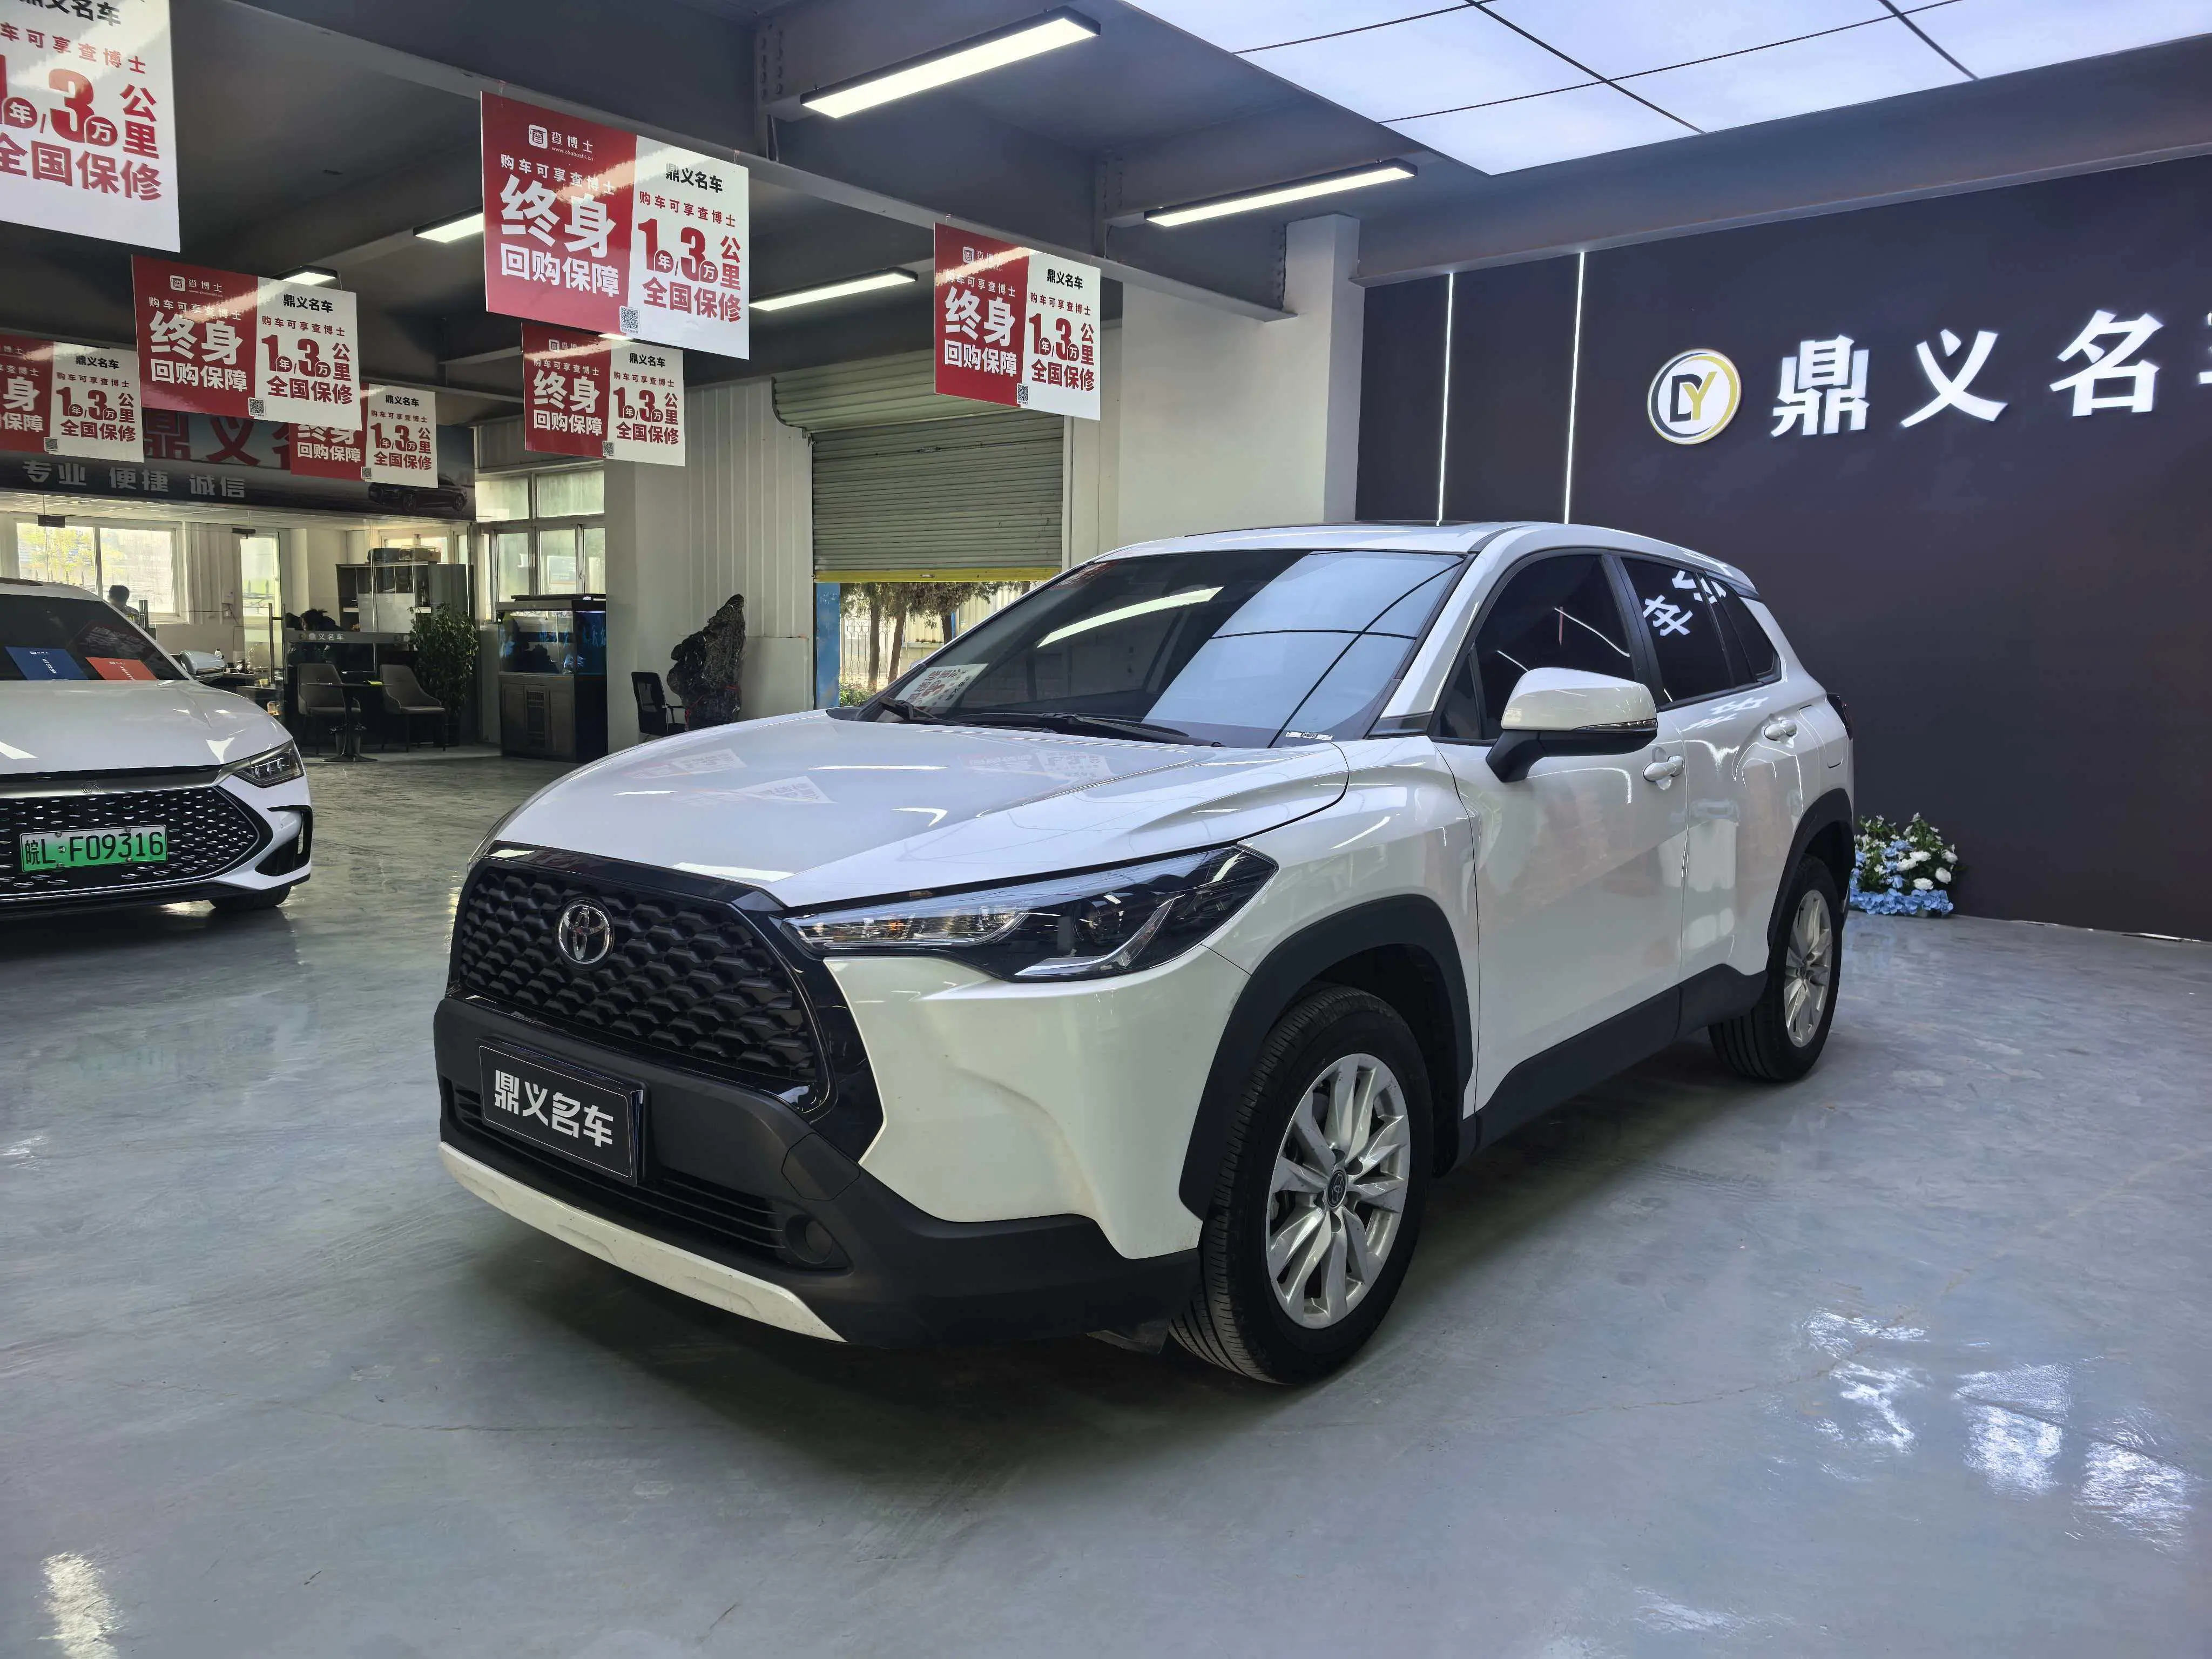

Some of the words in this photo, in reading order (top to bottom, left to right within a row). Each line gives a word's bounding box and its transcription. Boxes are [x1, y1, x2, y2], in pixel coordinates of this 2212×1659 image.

[0, 22, 146, 74] 车可享查博士
[551, 131, 593, 153] 查博士
[0, 132, 161, 201] 全国保修
[501, 153, 615, 195] 购车可享查博士
[666, 163, 723, 193] 鼎义名车
[500, 175, 616, 258] 终身
[639, 191, 736, 228] 购车可享查博士
[501, 243, 619, 298] 回购保障
[1047, 268, 1083, 290] 鼎义名车
[188, 279, 222, 292] 查博士
[642, 276, 741, 322] 全国保修
[149, 297, 241, 320] 购车可享查博士
[283, 294, 333, 313] 鼎义名车
[945, 286, 1016, 347] 终身
[1030, 292, 1091, 316] 购车可享查博士
[149, 311, 243, 366] 终身
[261, 315, 346, 337] 购车可享查博士
[75, 355, 119, 369] 鼎义名车
[629, 353, 666, 368] 鼎义名车
[945, 340, 1017, 377] 回购保障
[151, 359, 248, 392] 回购保障
[613, 371, 675, 387] 购车可享查博士
[1031, 359, 1095, 393] 全国保修
[1770, 309, 2212, 438] 鼎义名
[3, 376, 41, 412] 身
[266, 376, 353, 404] 全国保修
[386, 394, 420, 407] 鼎义名车
[533, 369, 601, 414] 终身
[0, 412, 44, 433] 保障
[60, 419, 136, 442] 全国保修
[533, 409, 603, 436] 回购保障
[616, 421, 679, 445] 全国保修
[298, 442, 361, 463] 回购保障
[374, 451, 432, 470] 全国保修
[22, 460, 87, 486] 专业
[109, 466, 169, 493] 便捷
[189, 474, 246, 498] 诚信
[495, 1069, 613, 1148] 鼎义名车
